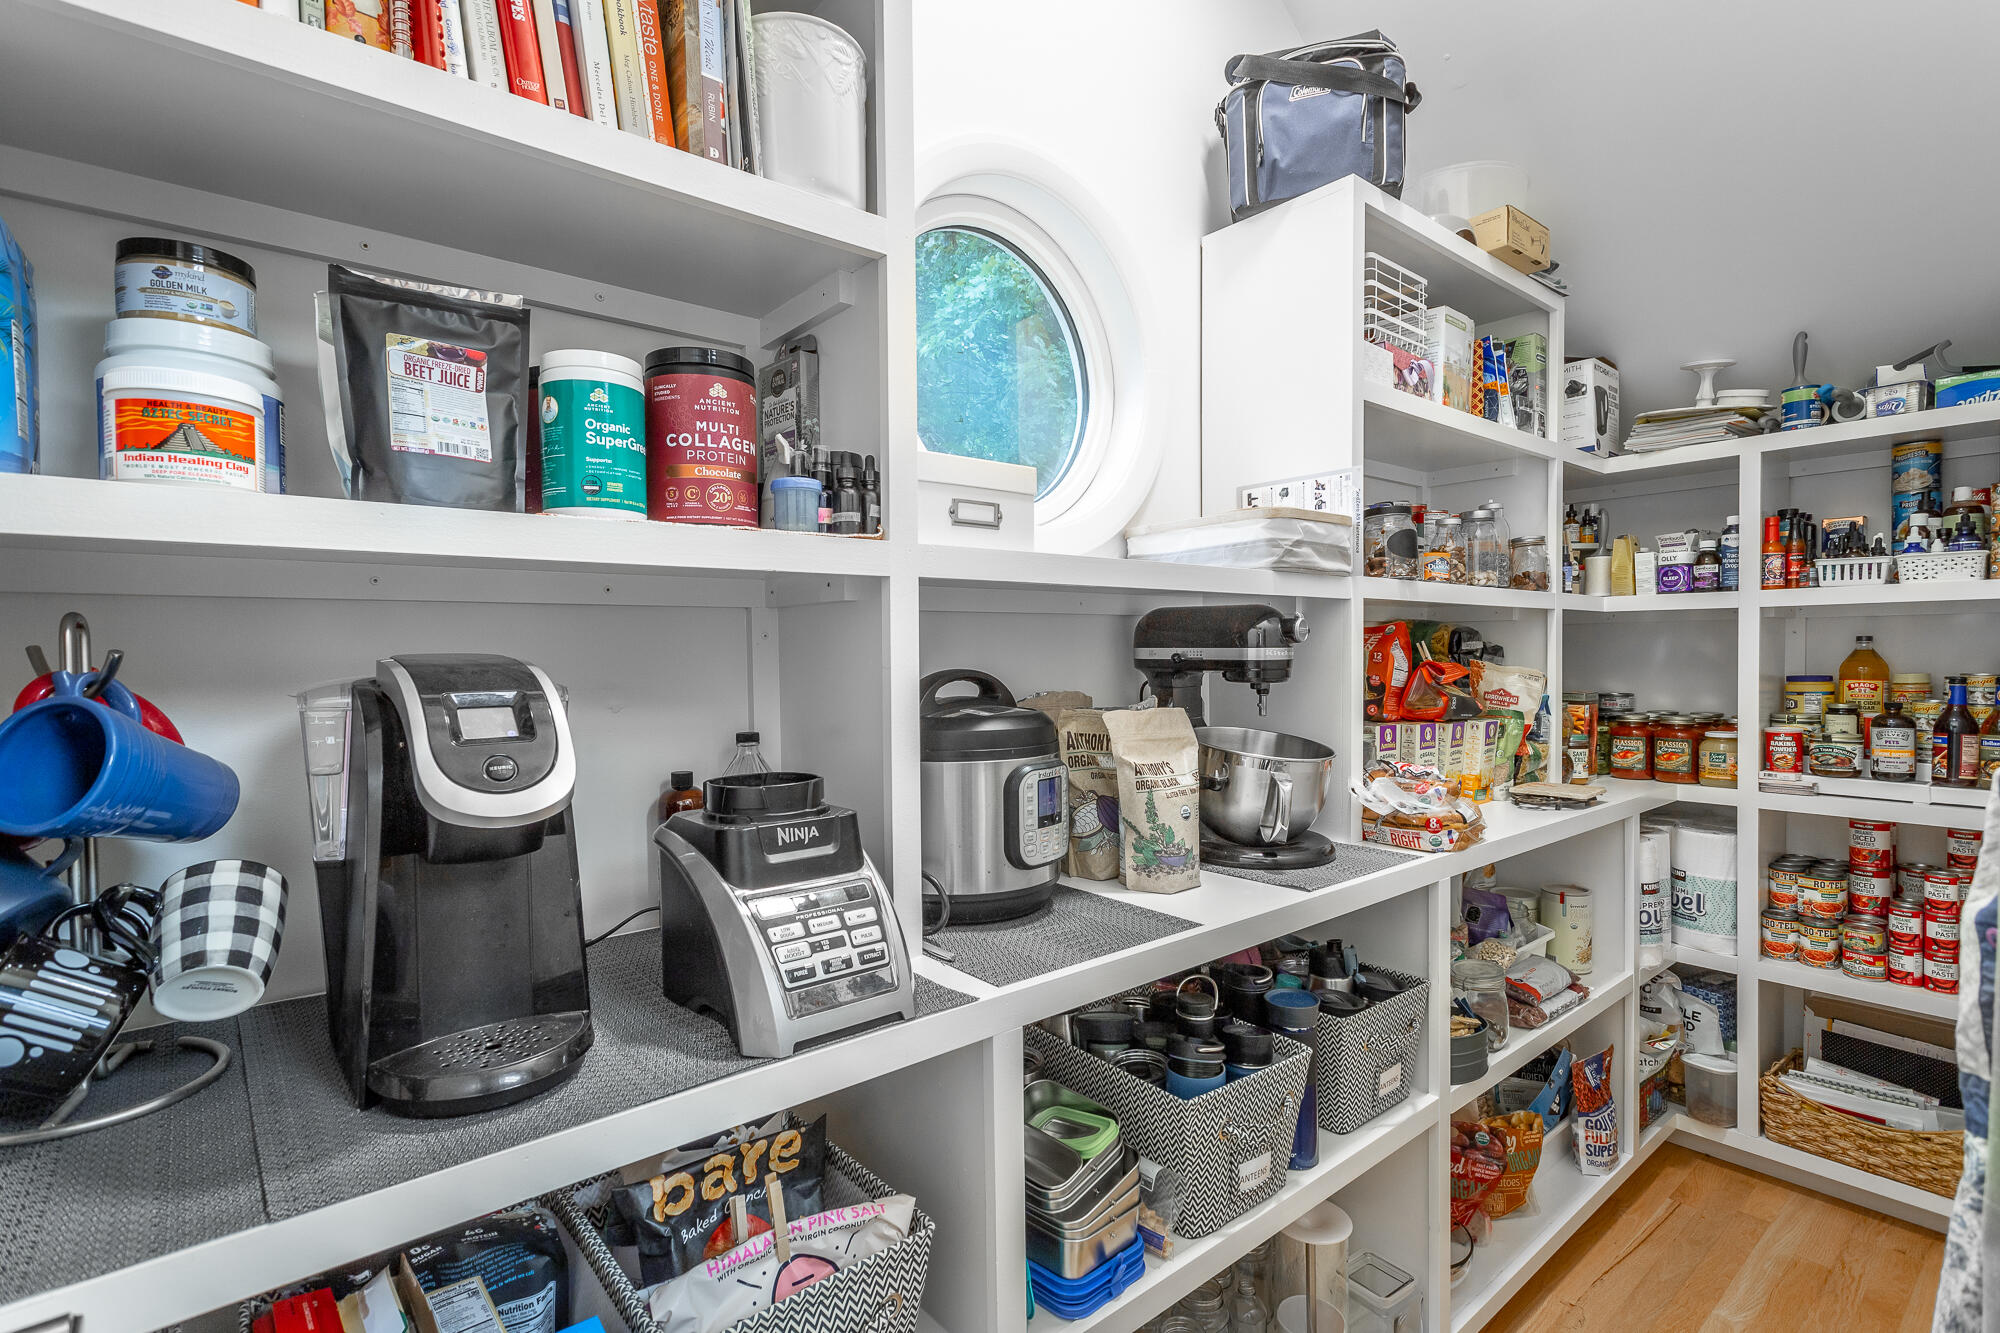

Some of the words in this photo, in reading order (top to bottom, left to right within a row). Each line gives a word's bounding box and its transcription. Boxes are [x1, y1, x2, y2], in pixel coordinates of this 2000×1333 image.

[649, 60, 659, 82] ONE
[592, 61, 604, 100] Mercedes
[651, 83, 658, 91] &
[652, 92, 664, 122] DONE
[707, 92, 717, 123] RUBIN
[150, 279, 183, 291] GOLDEN
[186, 283, 208, 296] MILK
[404, 354, 430, 366] ORGANIC
[431, 361, 471, 375] FREEZE-DRIED
[404, 361, 434, 380] BEET
[437, 370, 470, 389] JUICE
[653, 383, 677, 391] CLINICALLY
[147, 400, 183, 409] HEALTH
[195, 405, 230, 416] BEAUTY
[694, 405, 740, 416] NUTRITION
[699, 398, 736, 408] ANCIENT
[764, 400, 795, 420] NATURE'S
[142, 407, 184, 420] AZTEC
[188, 411, 234, 428] SECRET
[763, 411, 796, 429] PROTECTION
[584, 418, 631, 435] Organic
[696, 420, 739, 436] MULTI
[585, 431, 646, 456] SuperGre
[666, 432, 756, 456] COLLAGEN
[124, 453, 164, 462] Indian
[168, 454, 222, 470] Healing
[225, 461, 249, 475] Clay
[686, 449, 746, 466] PROTEIN
[1895, 450, 1927, 462] PROGRESSO
[694, 467, 742, 480] Chocolate
[1484, 692, 1518, 704] ARROWHEAD
[1613, 737, 1643, 746] CLASSICO
[1657, 740, 1688, 748] CLASSICO
[1134, 760, 1175, 777] ANTHONY'S
[1159, 777, 1180, 789] BLACK
[776, 825, 820, 847] NINJA
[1390, 832, 1422, 848] RIGHT
[1852, 834, 1876, 843] DICED
[1952, 846, 1975, 854] PASTE
[1852, 880, 1876, 889] DICED
[1928, 890, 1951, 899] PASTE
[795, 907, 845, 920] PROFESSIONAL
[1891, 923, 1914, 932] PASTE
[1935, 930, 1959, 938] PASTE
[783, 950, 806, 959] BOOST
[863, 952, 882, 960] EXTRACT
[1931, 970, 1956, 979] PASTE
[1379, 1075, 1399, 1089] ANTEENS
[1585, 1115, 1610, 1131] GOJI
[1240, 1165, 1268, 1184] ANTEENS
[681, 1209, 718, 1245] Baked
[460, 1231, 499, 1242] PROTEIN
[706, 1221, 803, 1279] HIMALAN
[807, 1209, 847, 1231] PINK
[851, 1203, 887, 1220] SALT
[410, 1245, 443, 1265] SUGAR
[716, 1267, 737, 1284] WITH
[737, 1246, 773, 1272] ORGANIC
[799, 1228, 827, 1243] VIRGIN
[827, 1219, 866, 1235] COCONUT
[429, 1286, 456, 1301] Nutrition
[457, 1279, 476, 1289] Facts
[497, 1302, 535, 1317] Nutrition
